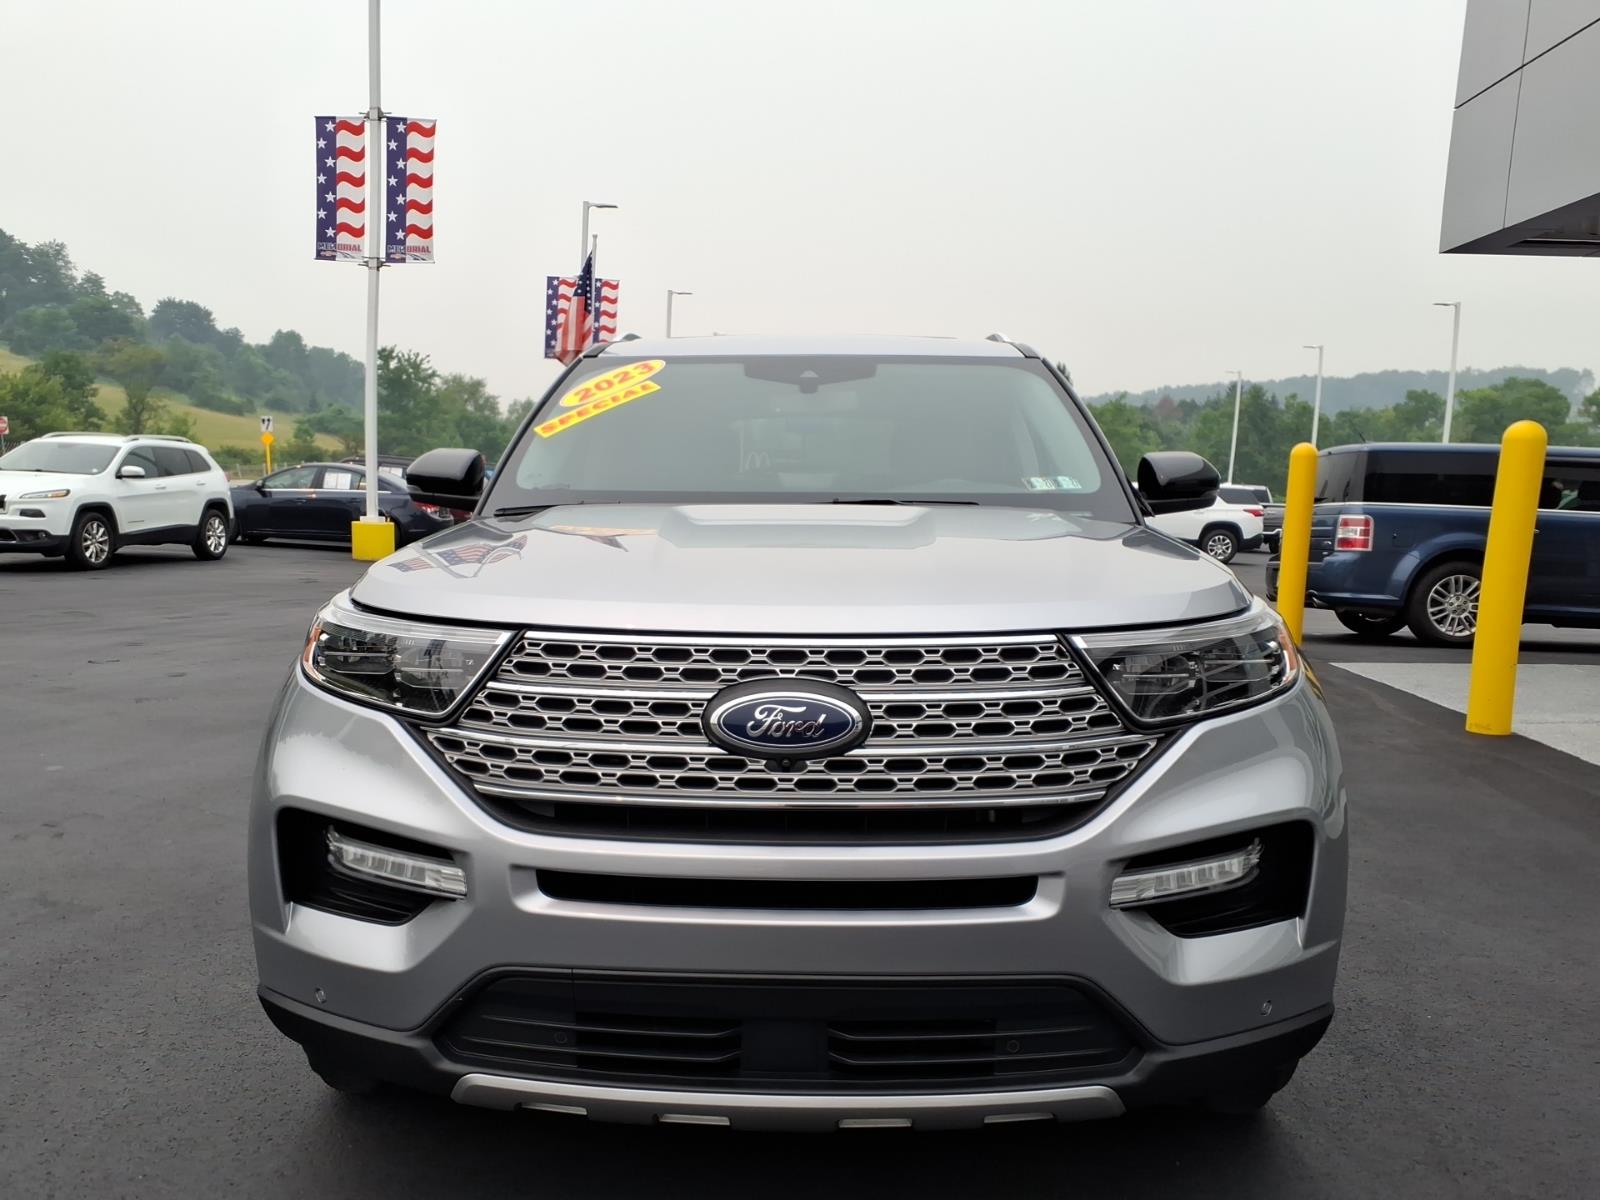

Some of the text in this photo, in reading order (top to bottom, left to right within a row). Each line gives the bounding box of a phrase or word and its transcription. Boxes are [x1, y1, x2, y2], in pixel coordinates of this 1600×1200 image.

[574, 362, 655, 403] 2023
[540, 383, 653, 434] SPECIAL
[746, 704, 827, 738] Ford
